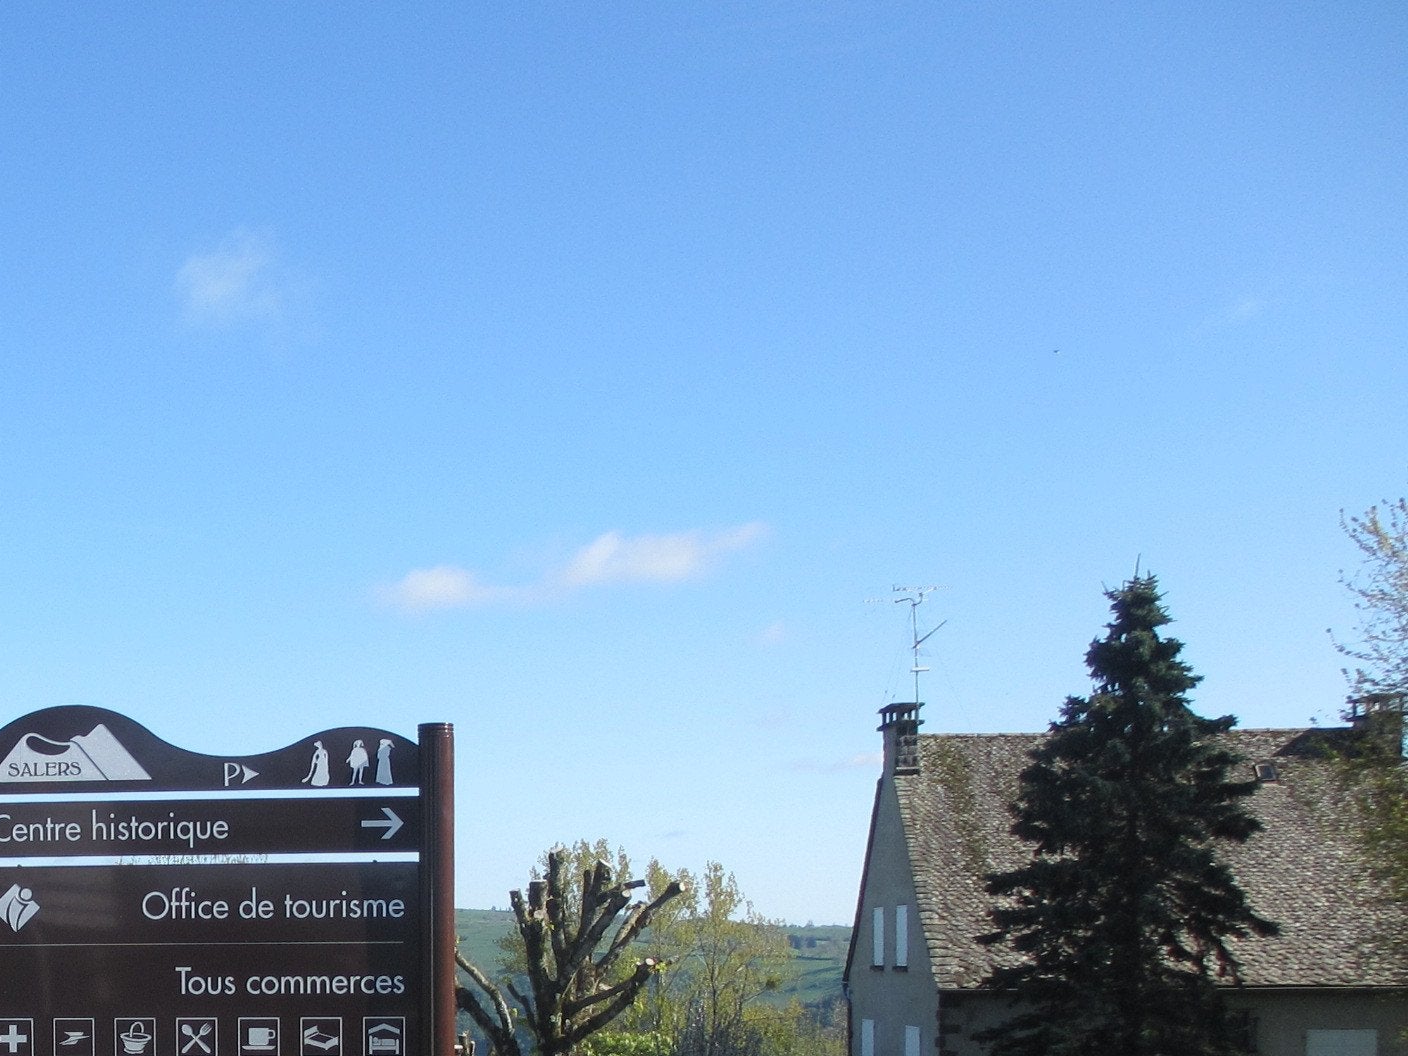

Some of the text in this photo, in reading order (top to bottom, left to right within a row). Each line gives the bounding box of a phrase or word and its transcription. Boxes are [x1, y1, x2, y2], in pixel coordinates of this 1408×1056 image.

[8, 761, 82, 777] SALERS
[92, 808, 229, 849] historique
[142, 886, 405, 920] Office de tourisme
[175, 966, 405, 995] Tous commerces
